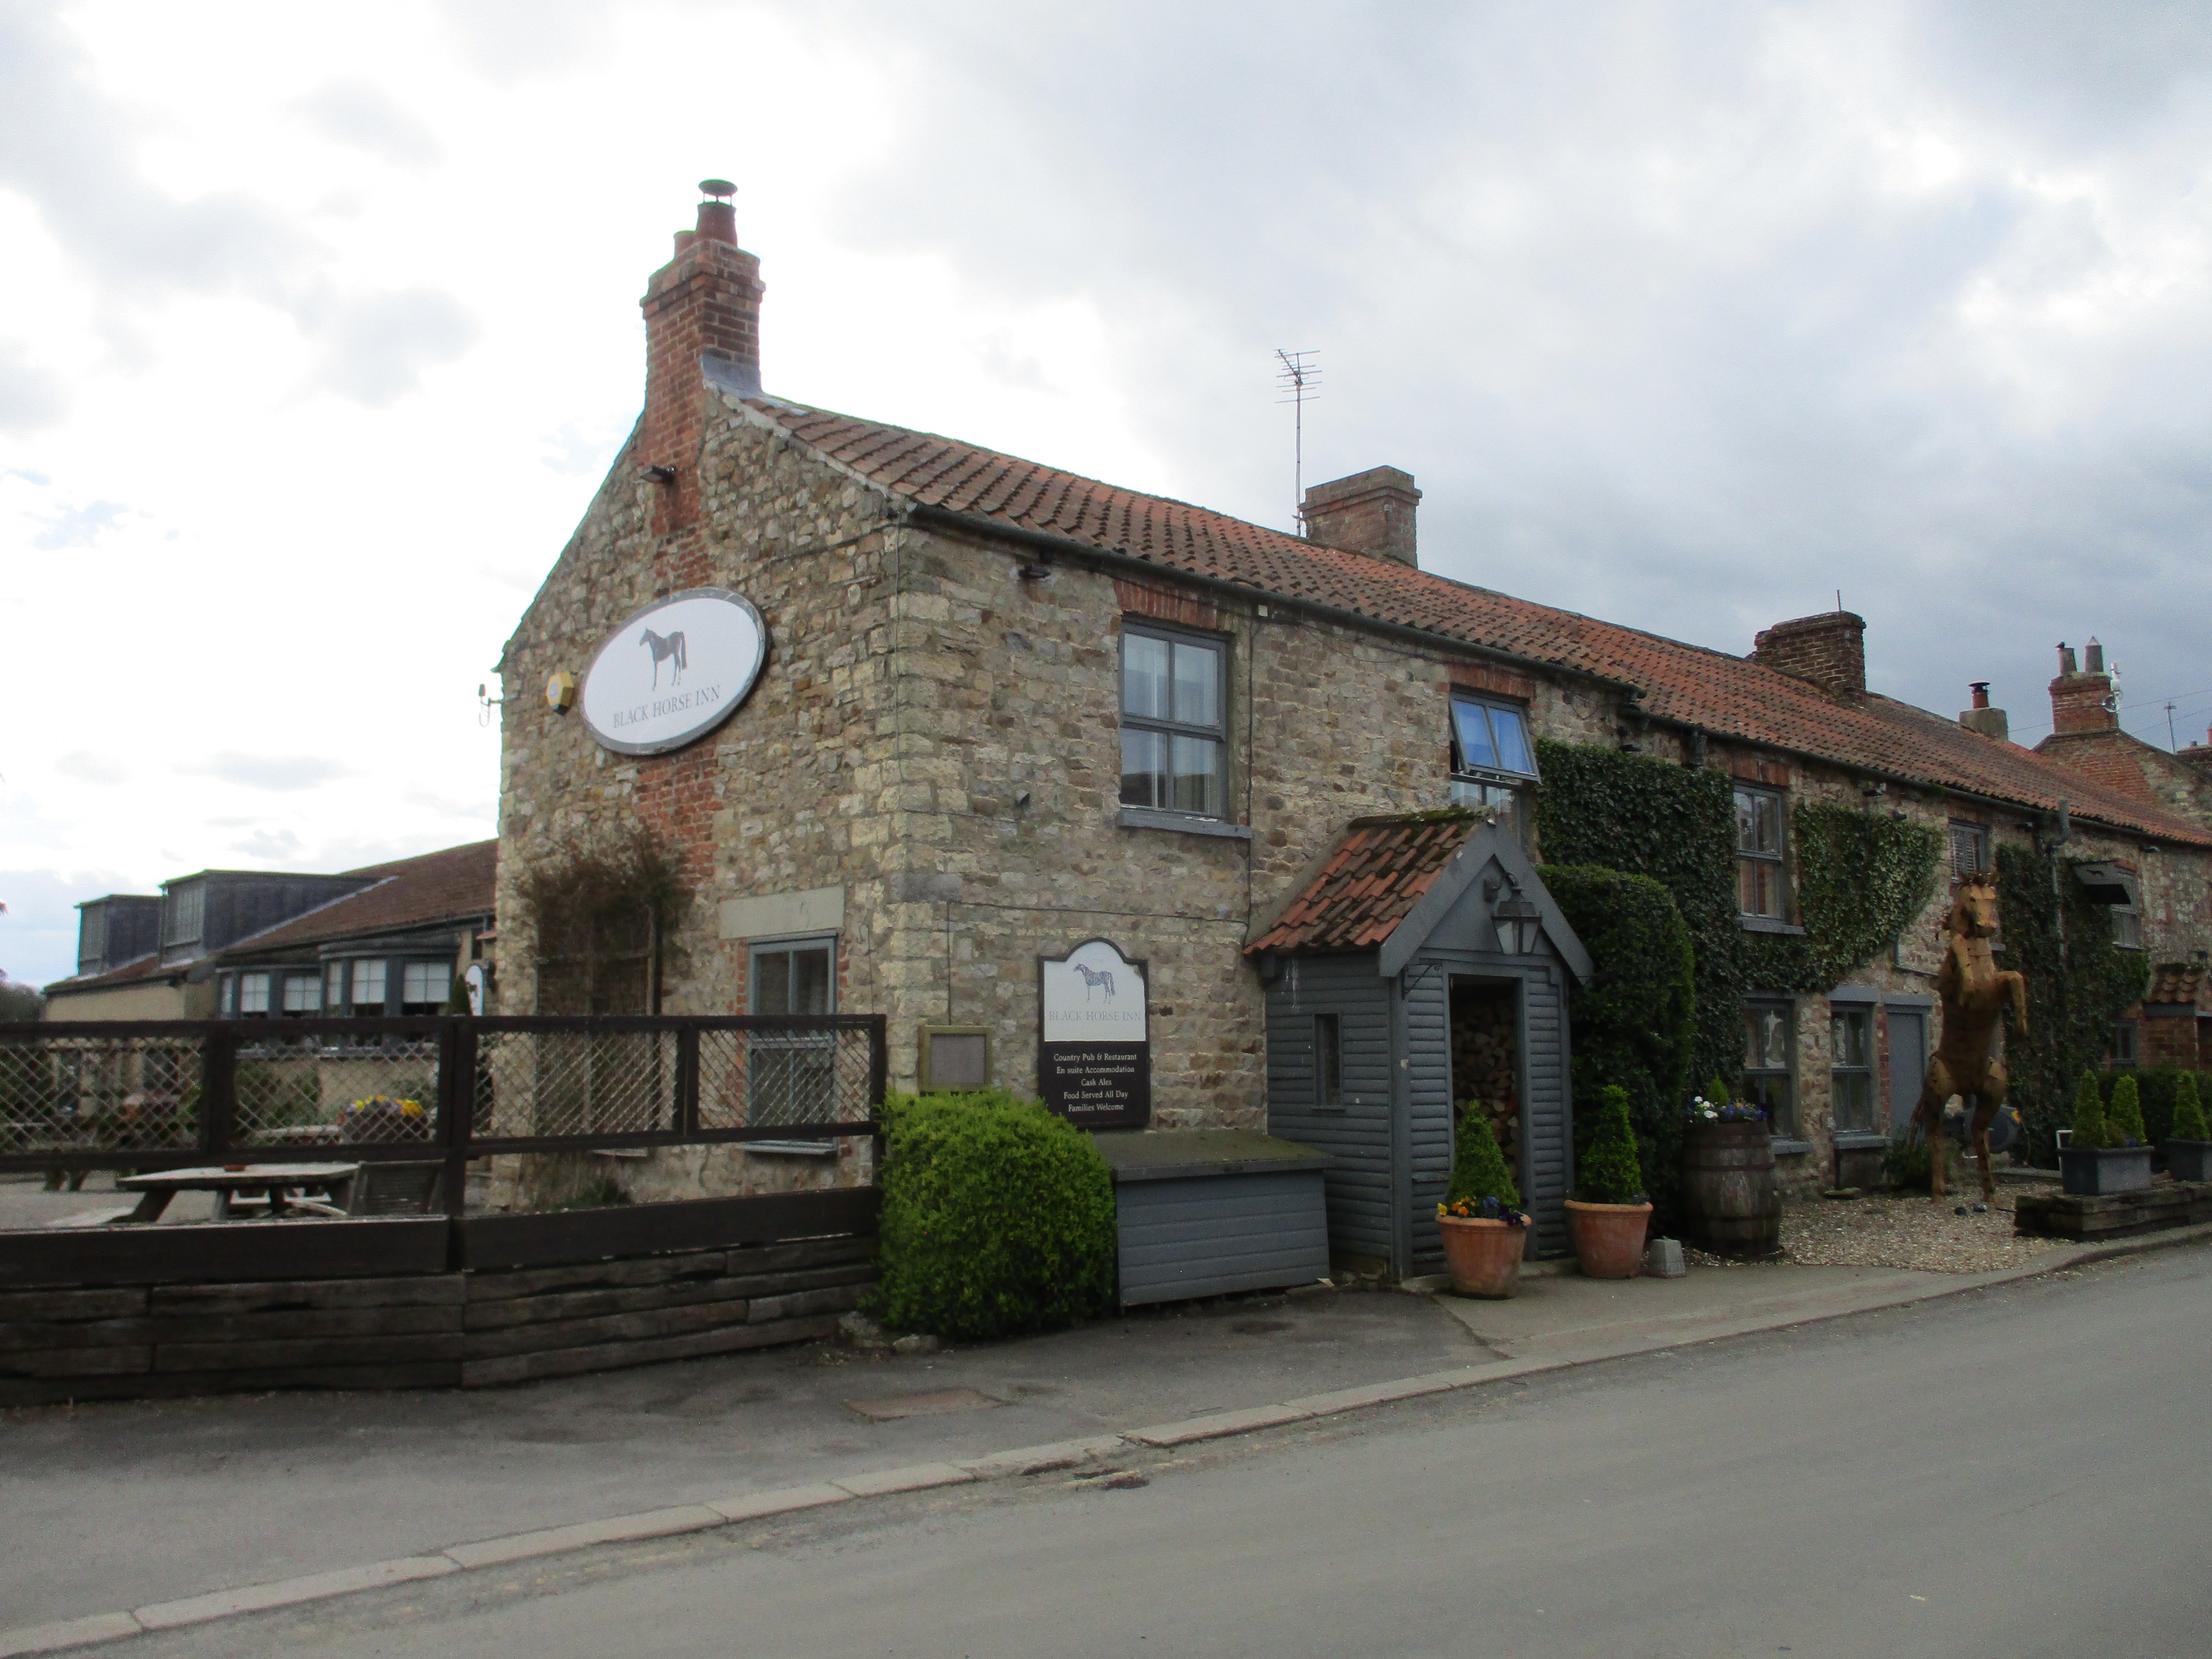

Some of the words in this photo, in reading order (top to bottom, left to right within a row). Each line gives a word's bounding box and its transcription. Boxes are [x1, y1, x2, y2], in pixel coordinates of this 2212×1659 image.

[614, 705, 649, 729] BLACK
[653, 693, 692, 717] HORSE
[696, 685, 721, 705] INN
[1049, 1011, 1082, 1021] BLACK
[1086, 1011, 1119, 1021] HORSE
[1122, 1011, 1142, 1021] INN
[1054, 1054, 1081, 1063] Country
[1085, 1065, 1134, 1073] Accommodation
[1081, 1078, 1097, 1086] Cask
[1063, 1091, 1079, 1099] Food
[1082, 1091, 1103, 1099] Served
[1116, 1090, 1128, 1099] Day
[1068, 1103, 1095, 1112] Families
